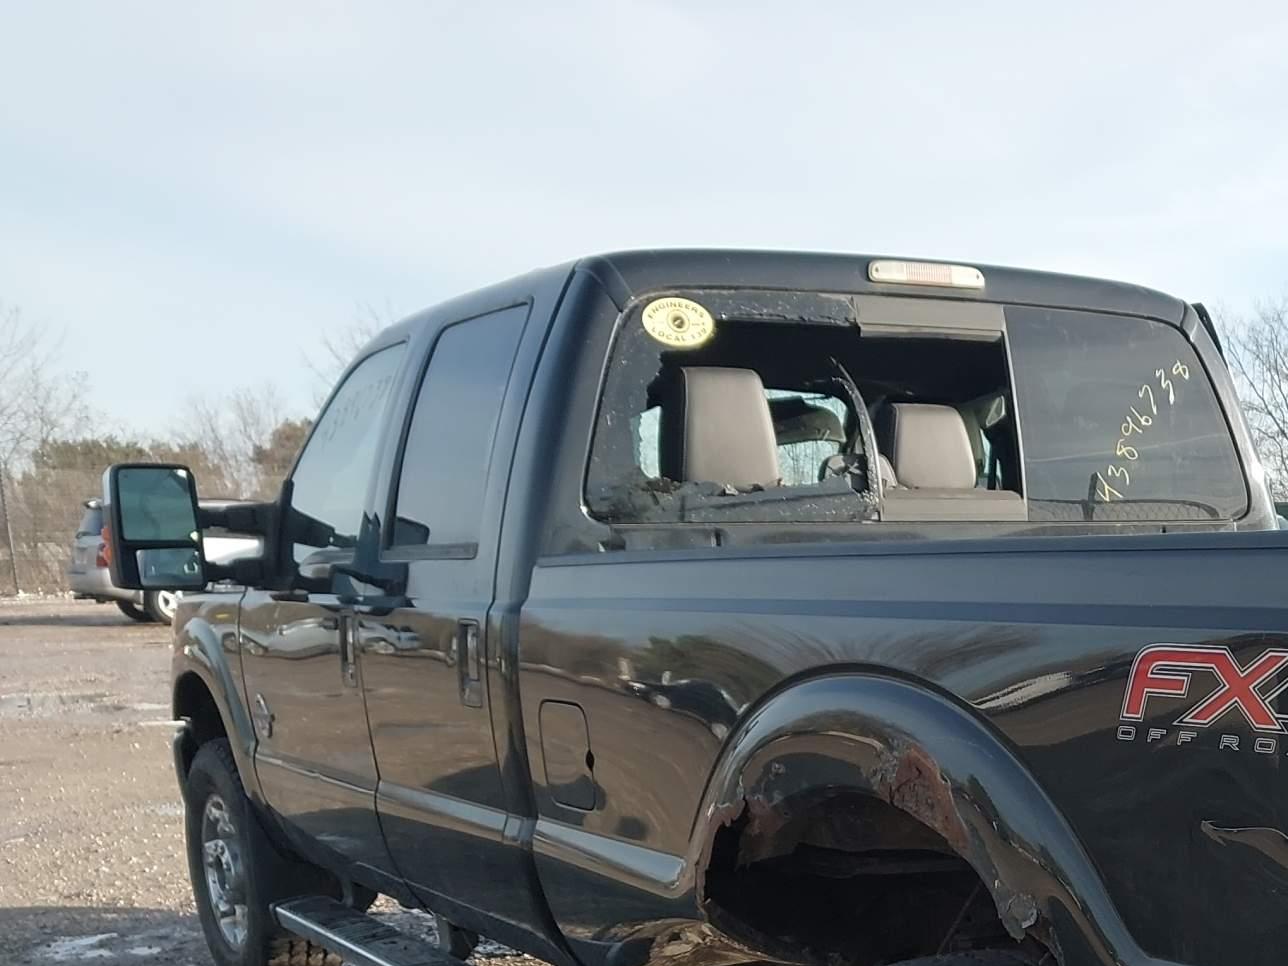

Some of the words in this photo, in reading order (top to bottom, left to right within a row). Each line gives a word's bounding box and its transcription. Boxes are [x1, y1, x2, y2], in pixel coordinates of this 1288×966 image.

[647, 301, 705, 319] ENGINEERS
[651, 327, 687, 342] LOCAL
[1096, 360, 1189, 501] 43896738
[1117, 726, 1197, 746] OFF
